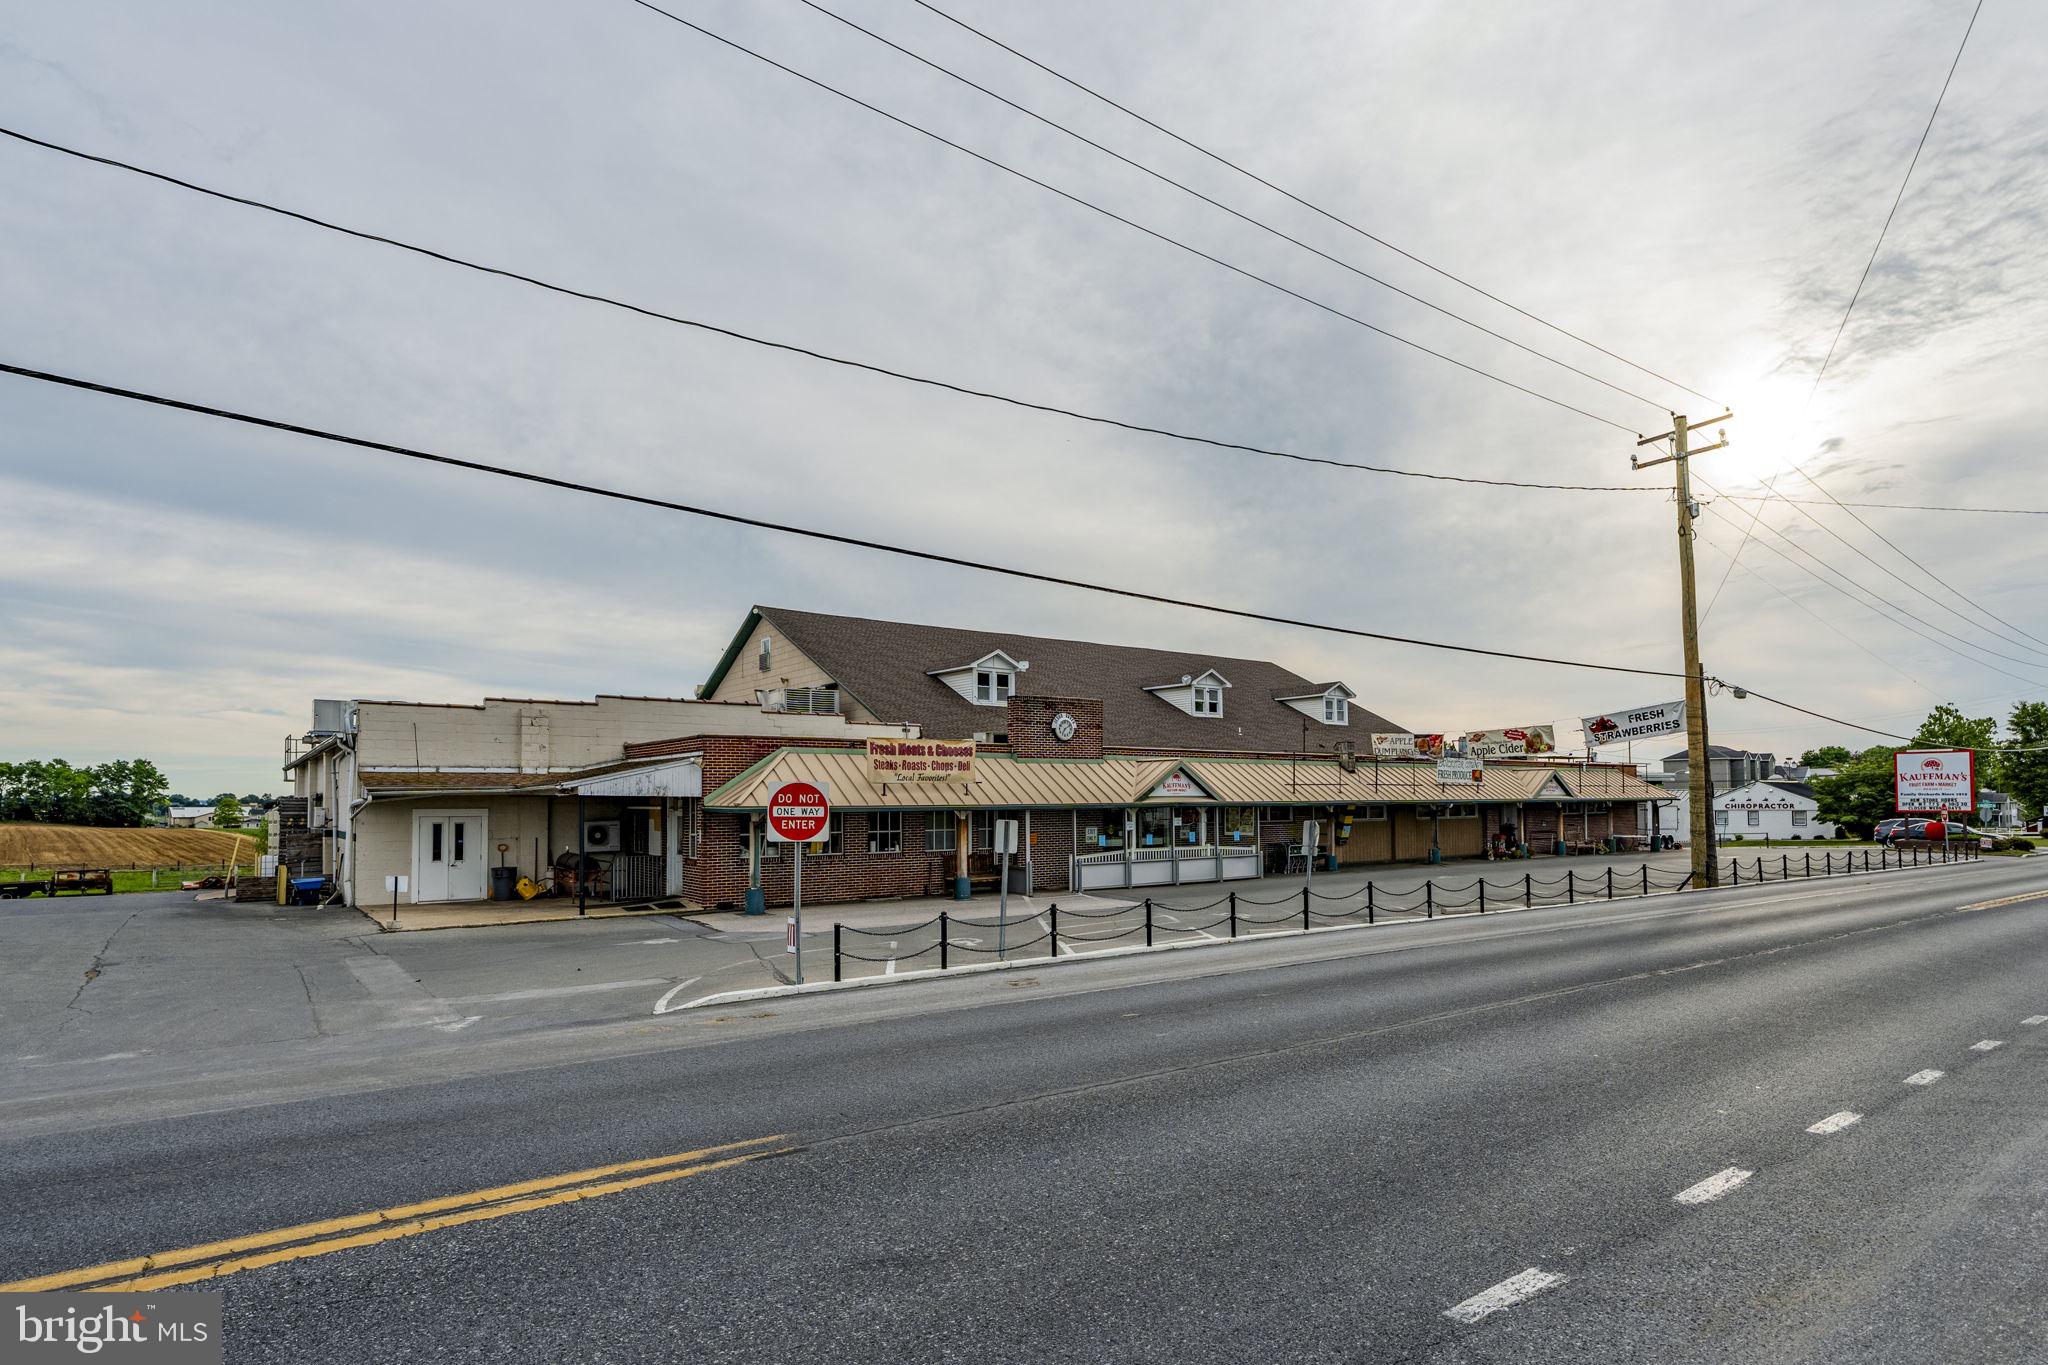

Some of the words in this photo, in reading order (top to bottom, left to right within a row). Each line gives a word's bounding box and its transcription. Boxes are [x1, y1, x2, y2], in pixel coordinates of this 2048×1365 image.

[1628, 709, 1665, 723] FRESH
[1594, 719, 1681, 742] STRAWBERRIES
[1390, 737, 1413, 745] APPLE
[870, 741, 897, 756] Fresh
[898, 743, 926, 756] Meats
[927, 745, 934, 757] &
[935, 744, 974, 757] Cheeses
[1374, 748, 1420, 756] DUMPLINGS
[1471, 746, 1496, 759] Apple
[1498, 743, 1524, 754] Cider
[873, 759, 898, 771] Steaks
[902, 759, 927, 771] Roasts
[931, 760, 954, 772] Chops
[958, 760, 971, 771] Deli
[1438, 770, 1451, 779] FRESH
[1452, 770, 1472, 780] PRODUCE
[1900, 772, 1968, 782] KAUFFMAN'S
[778, 793, 792, 803] DO
[799, 794, 820, 804] NOT
[776, 807, 795, 816] ONE
[801, 807, 820, 816] WAY
[781, 819, 816, 830] ENTER
